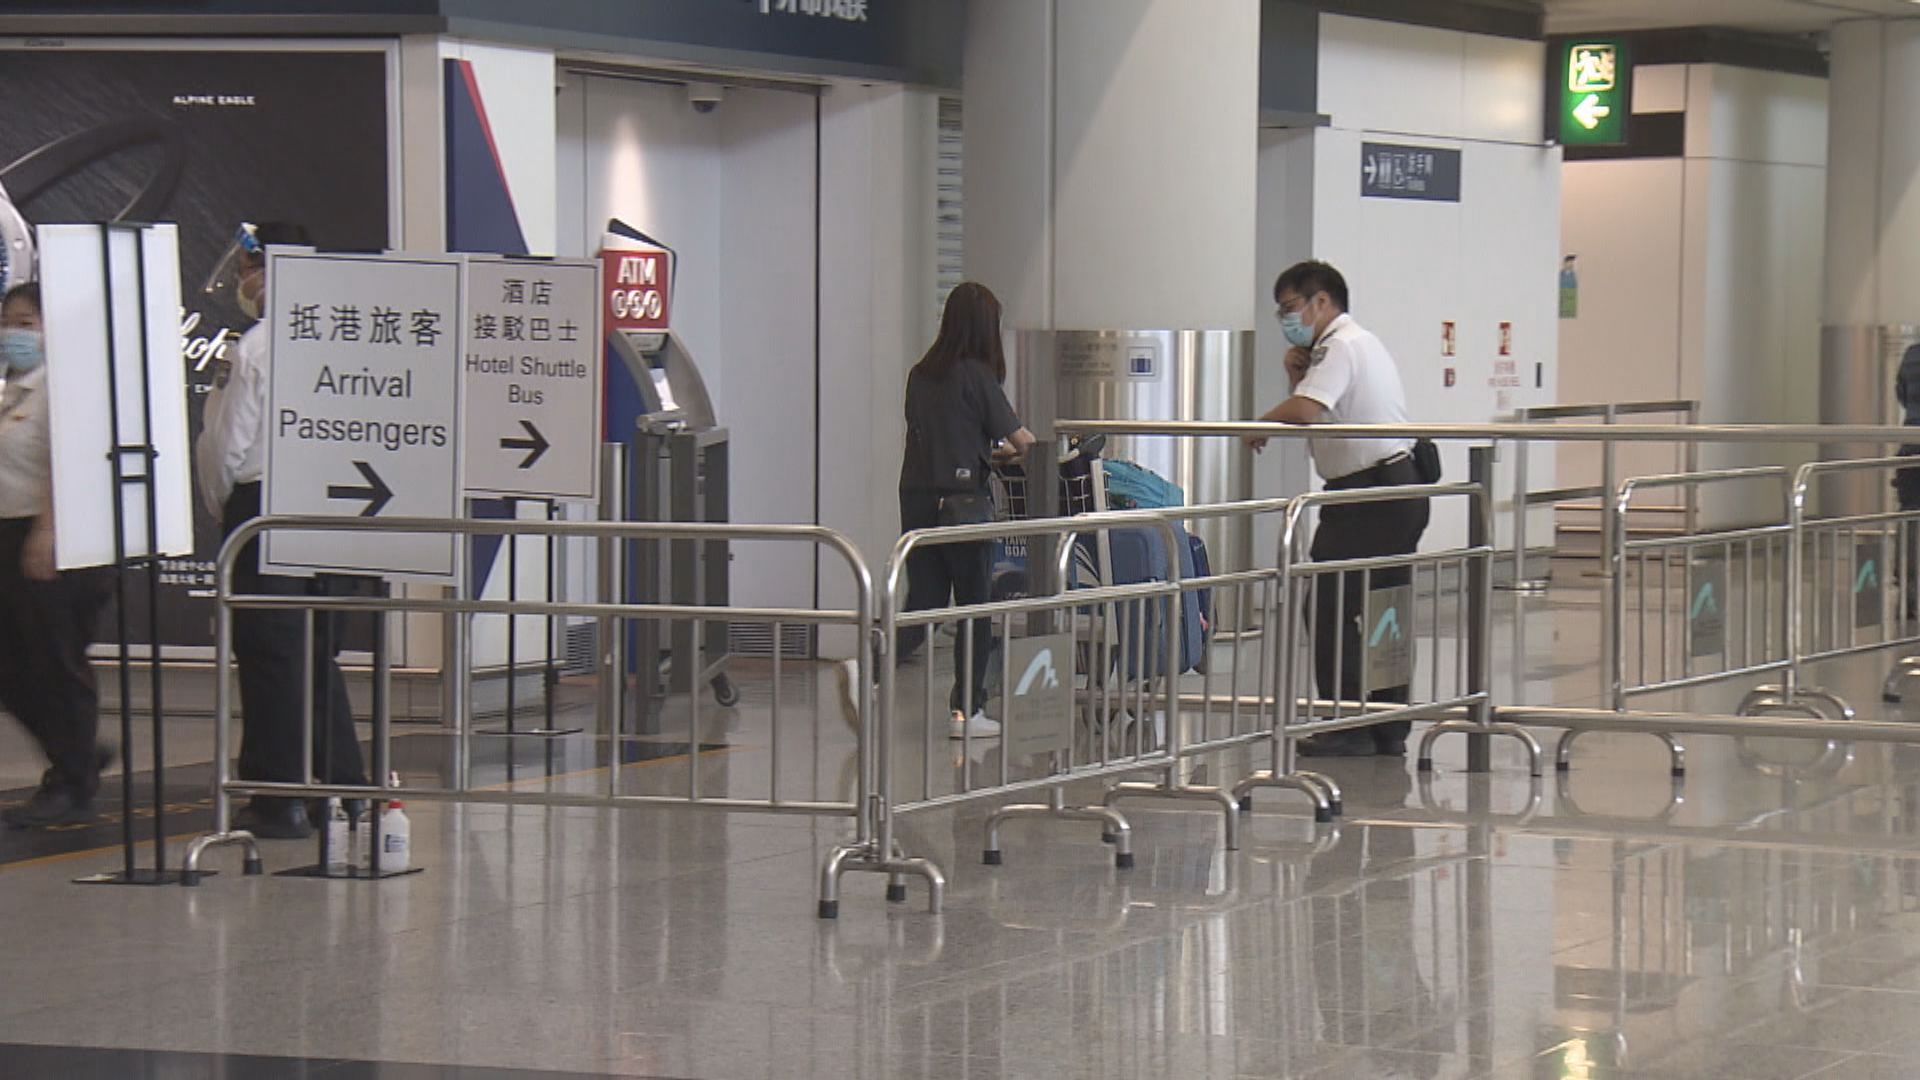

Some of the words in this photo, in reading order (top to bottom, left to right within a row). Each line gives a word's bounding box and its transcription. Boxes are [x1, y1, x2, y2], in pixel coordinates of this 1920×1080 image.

[173, 95, 215, 105] ALPINE
[217, 95, 256, 105] EAGLE
[617, 257, 656, 285] ATM
[502, 279, 552, 305] 酒店
[289, 303, 442, 347] 抵港旅客
[474, 314, 578, 341] 接駁巴士
[465, 354, 514, 373] Hotel
[520, 356, 586, 378] Shuttle
[313, 365, 412, 399] Arrival
[508, 384, 543, 405] Bus
[279, 408, 447, 451] Passengers
